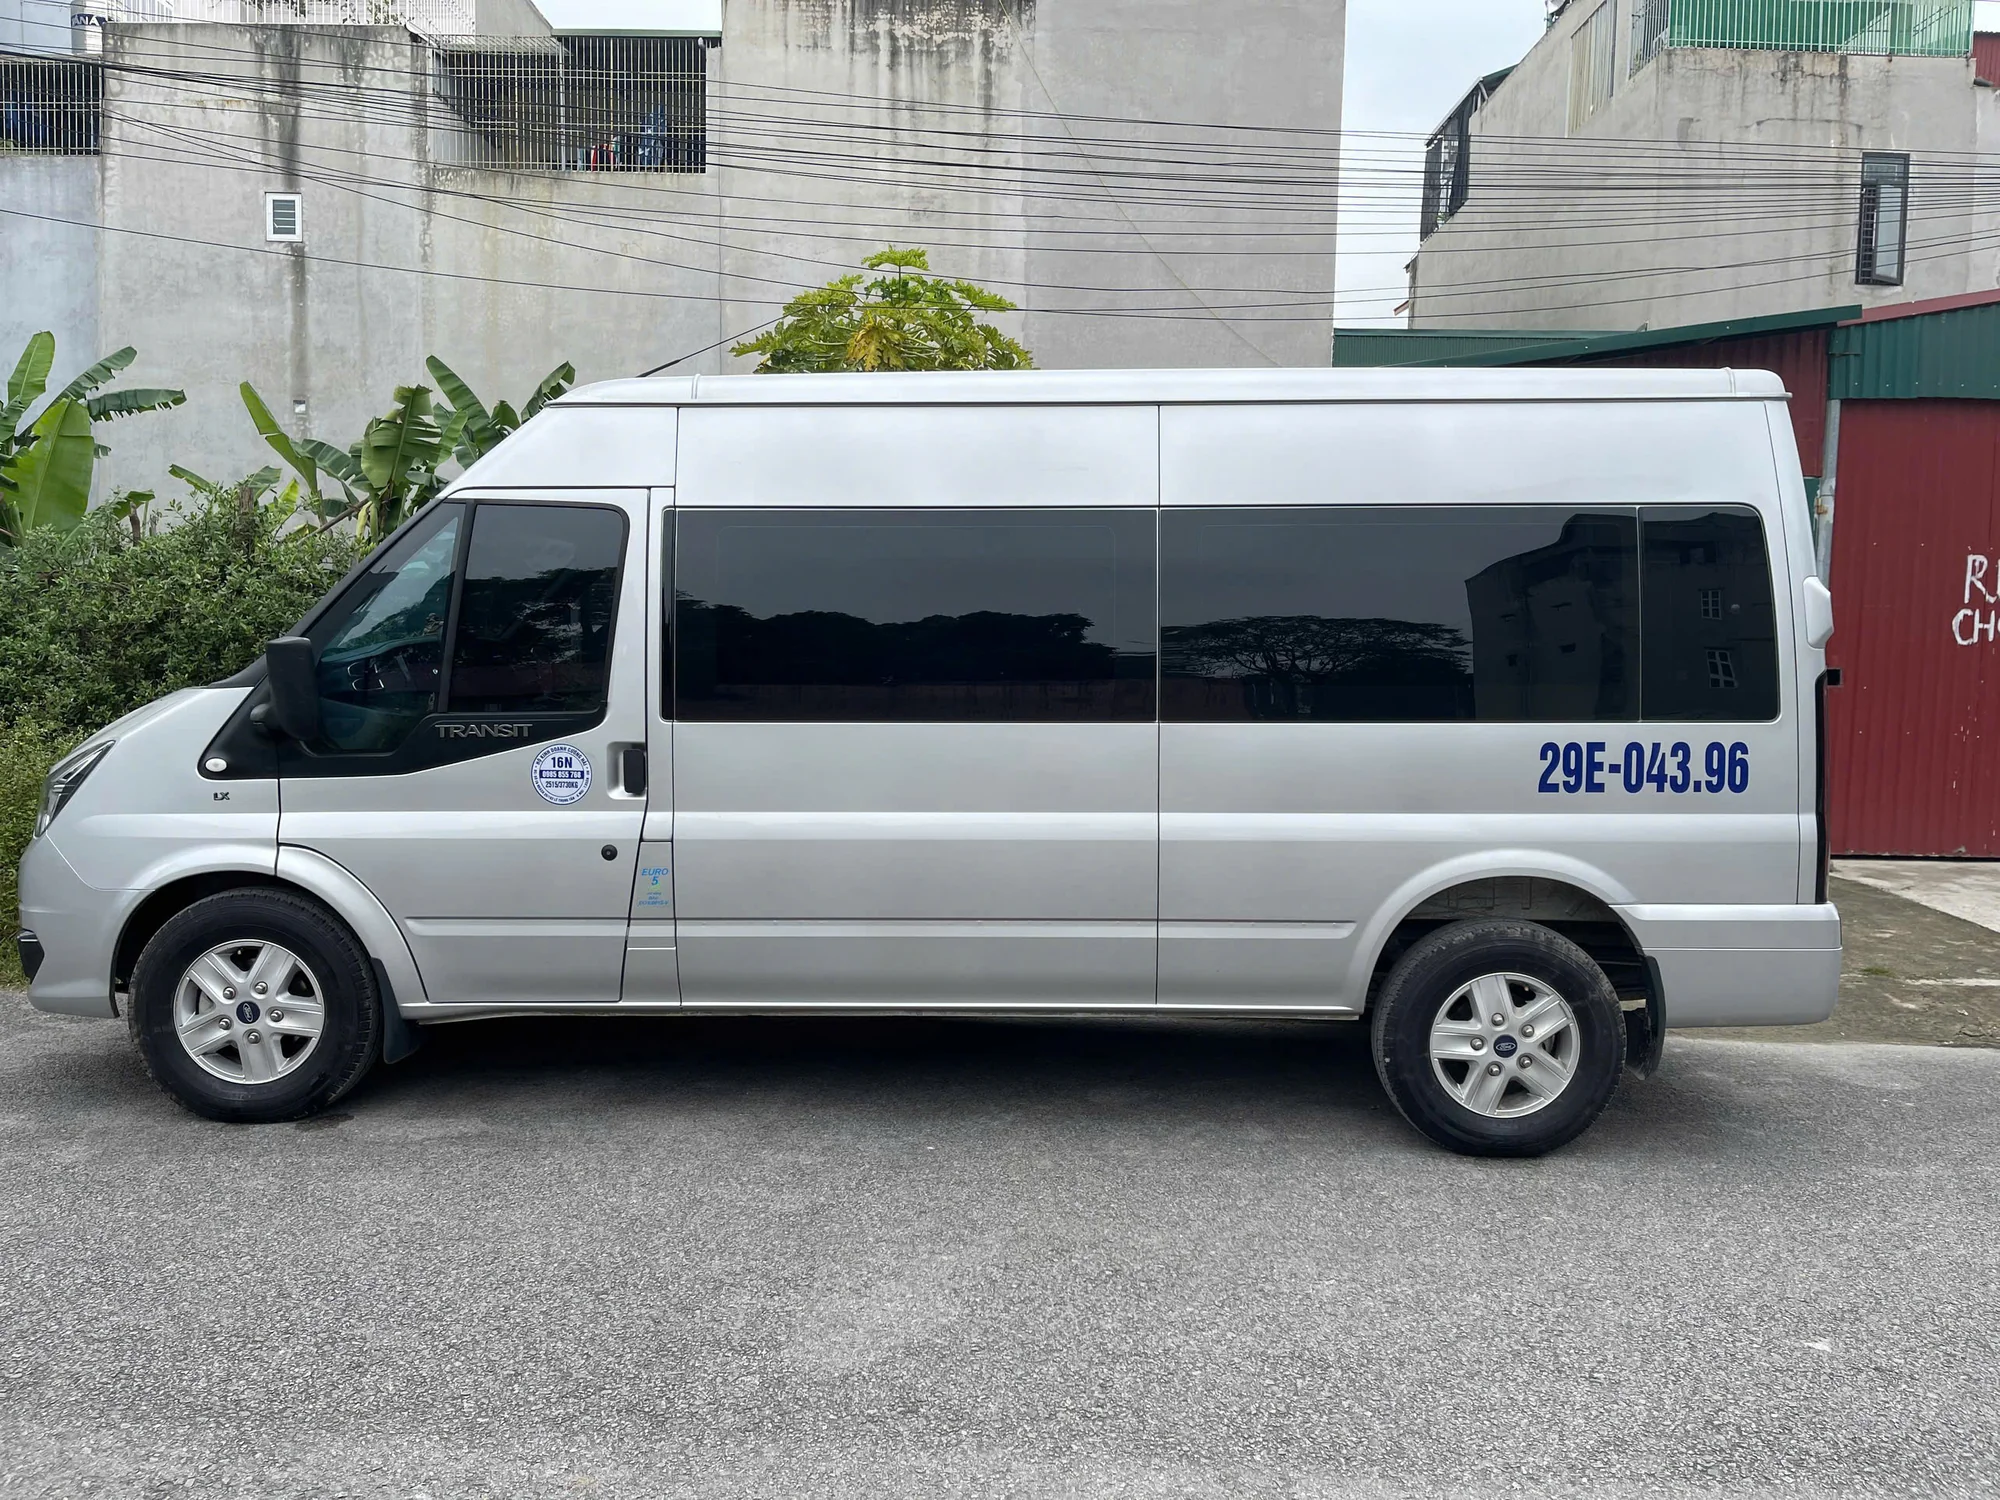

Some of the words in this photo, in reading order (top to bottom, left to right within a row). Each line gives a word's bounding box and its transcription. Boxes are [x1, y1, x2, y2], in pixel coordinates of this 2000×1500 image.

[1964, 554, 2000, 603] R
[1952, 608, 2000, 646] CH
[434, 723, 533, 738] TRANSIT
[551, 756, 573, 769] 16N
[1538, 741, 1749, 794] 29E-043.96
[641, 868, 669, 876] EURO
[651, 876, 659, 886] 5
